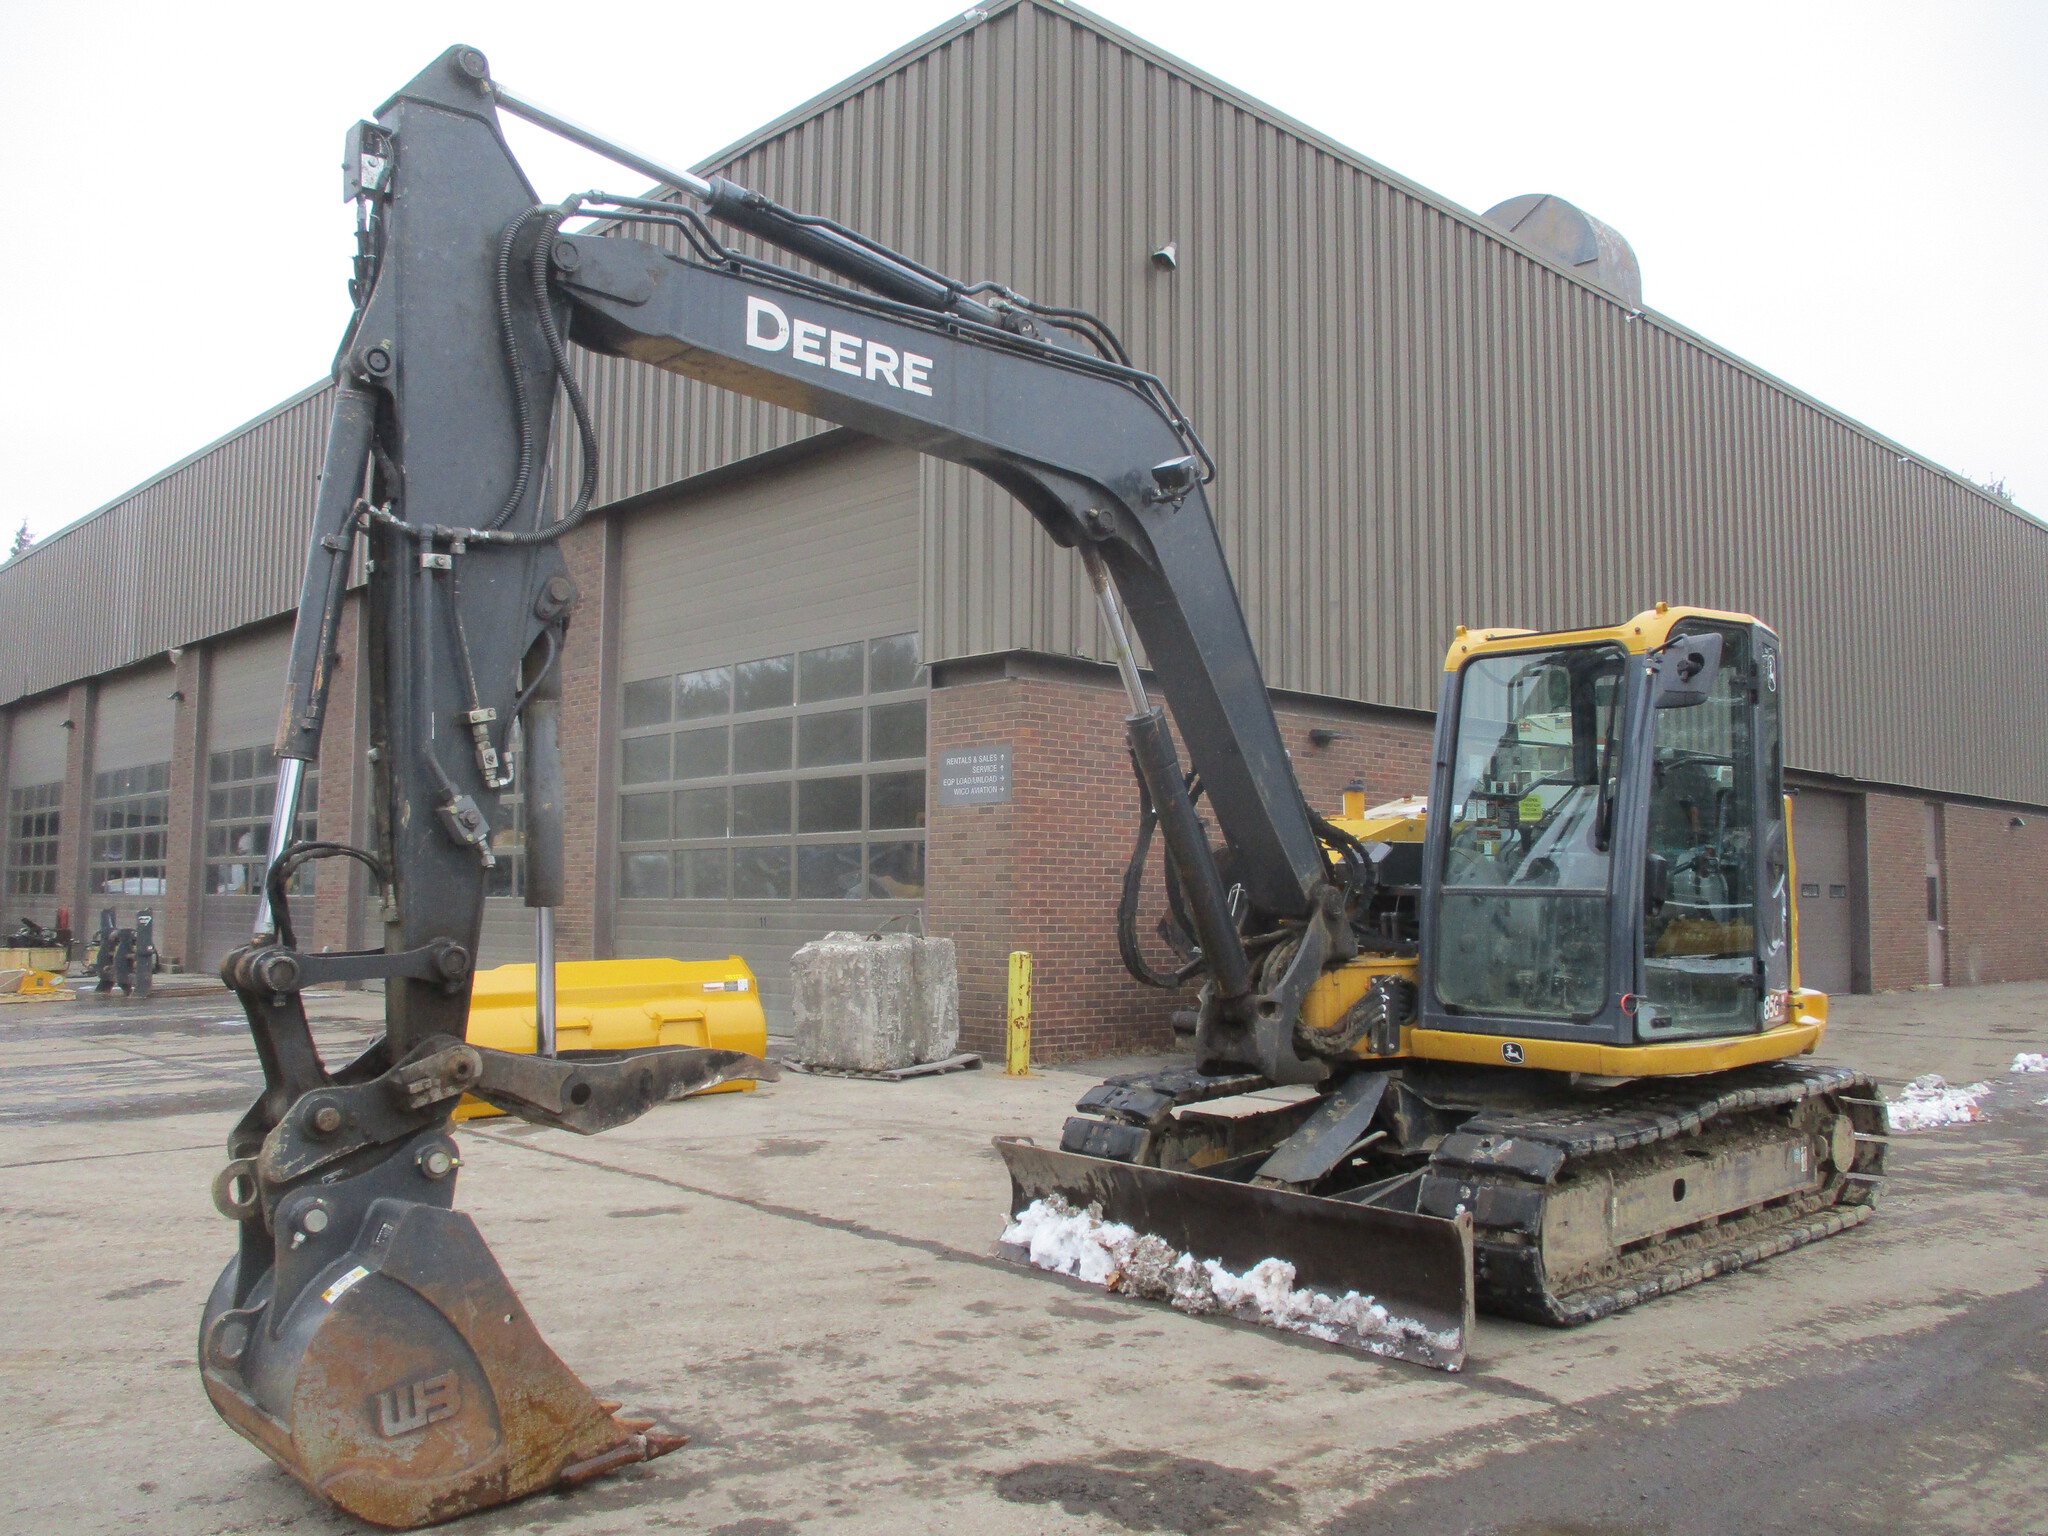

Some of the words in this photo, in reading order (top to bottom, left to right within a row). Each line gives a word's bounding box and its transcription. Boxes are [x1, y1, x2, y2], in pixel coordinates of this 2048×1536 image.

[746, 295, 933, 397] DEERE
[946, 756, 972, 765] RENTALS
[973, 756, 978, 764] &
[978, 754, 998, 762] SALES
[972, 764, 998, 774] SERVICE
[970, 786, 998, 794] AVIATION
